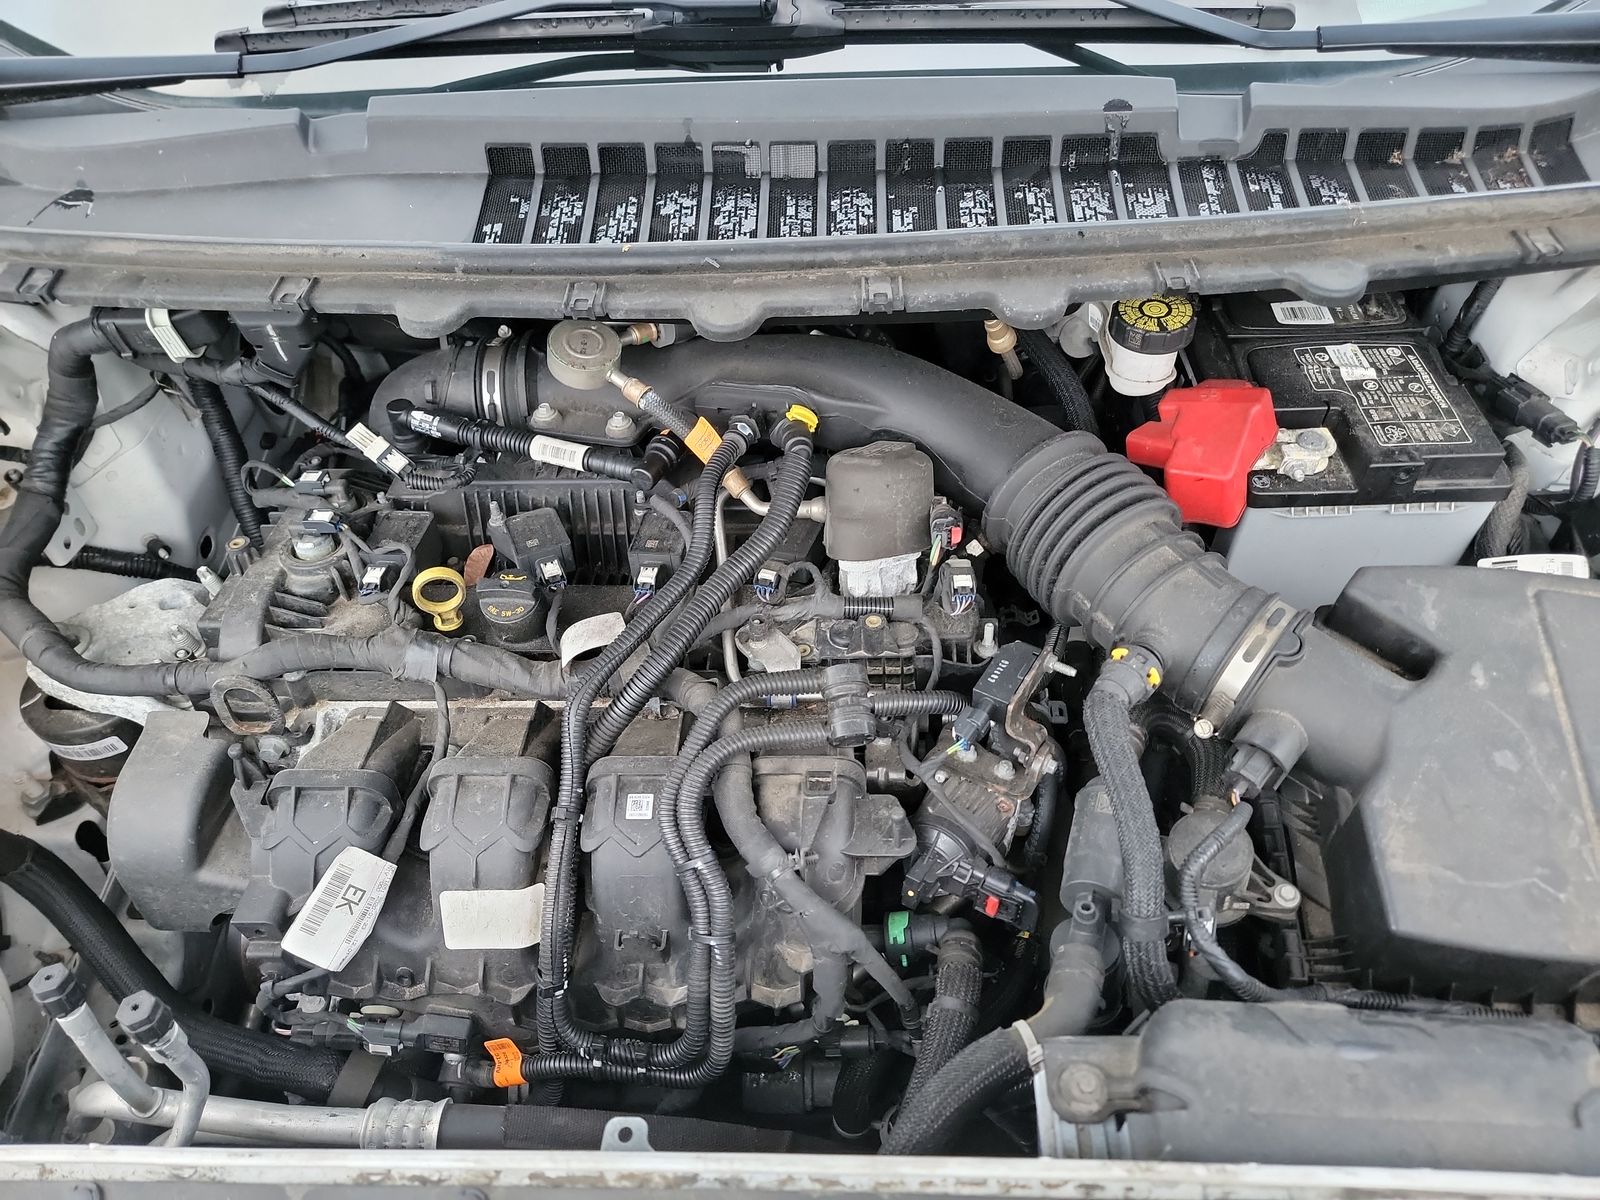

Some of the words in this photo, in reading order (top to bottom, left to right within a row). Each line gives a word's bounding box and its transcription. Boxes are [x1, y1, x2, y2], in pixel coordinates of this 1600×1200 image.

[487, 605, 499, 615] SAE
[501, 606, 525, 617] 5W-30
[335, 883, 367, 916] EK
